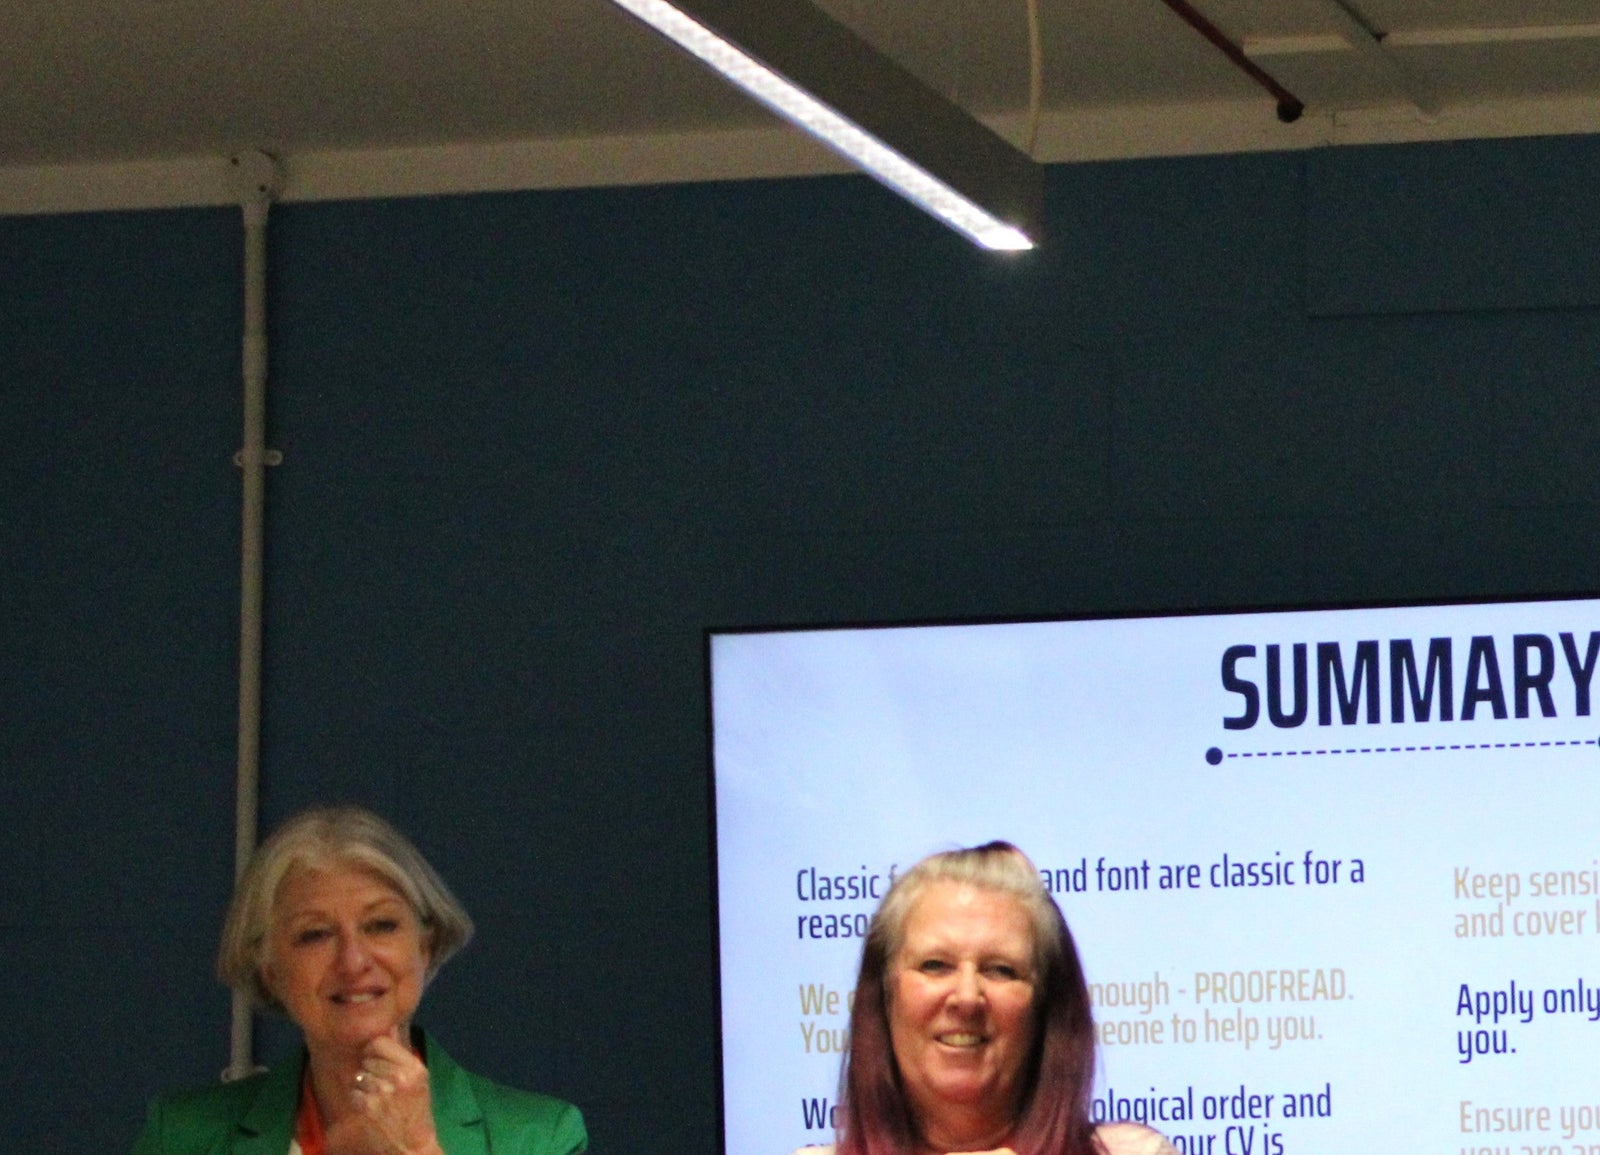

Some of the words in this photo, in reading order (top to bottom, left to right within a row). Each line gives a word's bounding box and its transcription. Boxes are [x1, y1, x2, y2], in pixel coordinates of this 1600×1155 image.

[797, 865, 880, 901] Classic
[1040, 858, 1087, 893] and
[1096, 857, 1150, 891] font
[1159, 865, 1200, 889] are
[1210, 852, 1294, 888] classic
[1303, 850, 1341, 884] for
[1350, 859, 1364, 883] a
[1454, 867, 1520, 906] Keep
[798, 914, 867, 939] reaso
[1454, 902, 1504, 938] and
[1513, 910, 1586, 937] cover
[799, 984, 839, 1016] We
[1087, 971, 1169, 1014] nough
[1195, 968, 1353, 1004] PROOFREAD.
[1457, 980, 1533, 1024] Apply
[1543, 978, 1600, 1021] only
[800, 1021, 847, 1054] You
[1095, 1019, 1164, 1046] eone
[1171, 1013, 1197, 1044] to
[1204, 1007, 1259, 1050] help
[1267, 1016, 1322, 1050] you.
[1458, 1030, 1516, 1064] you.
[1092, 1086, 1194, 1123] ological
[1203, 1085, 1274, 1120] order
[1283, 1083, 1331, 1118] and
[1460, 1100, 1550, 1133] Ensure
